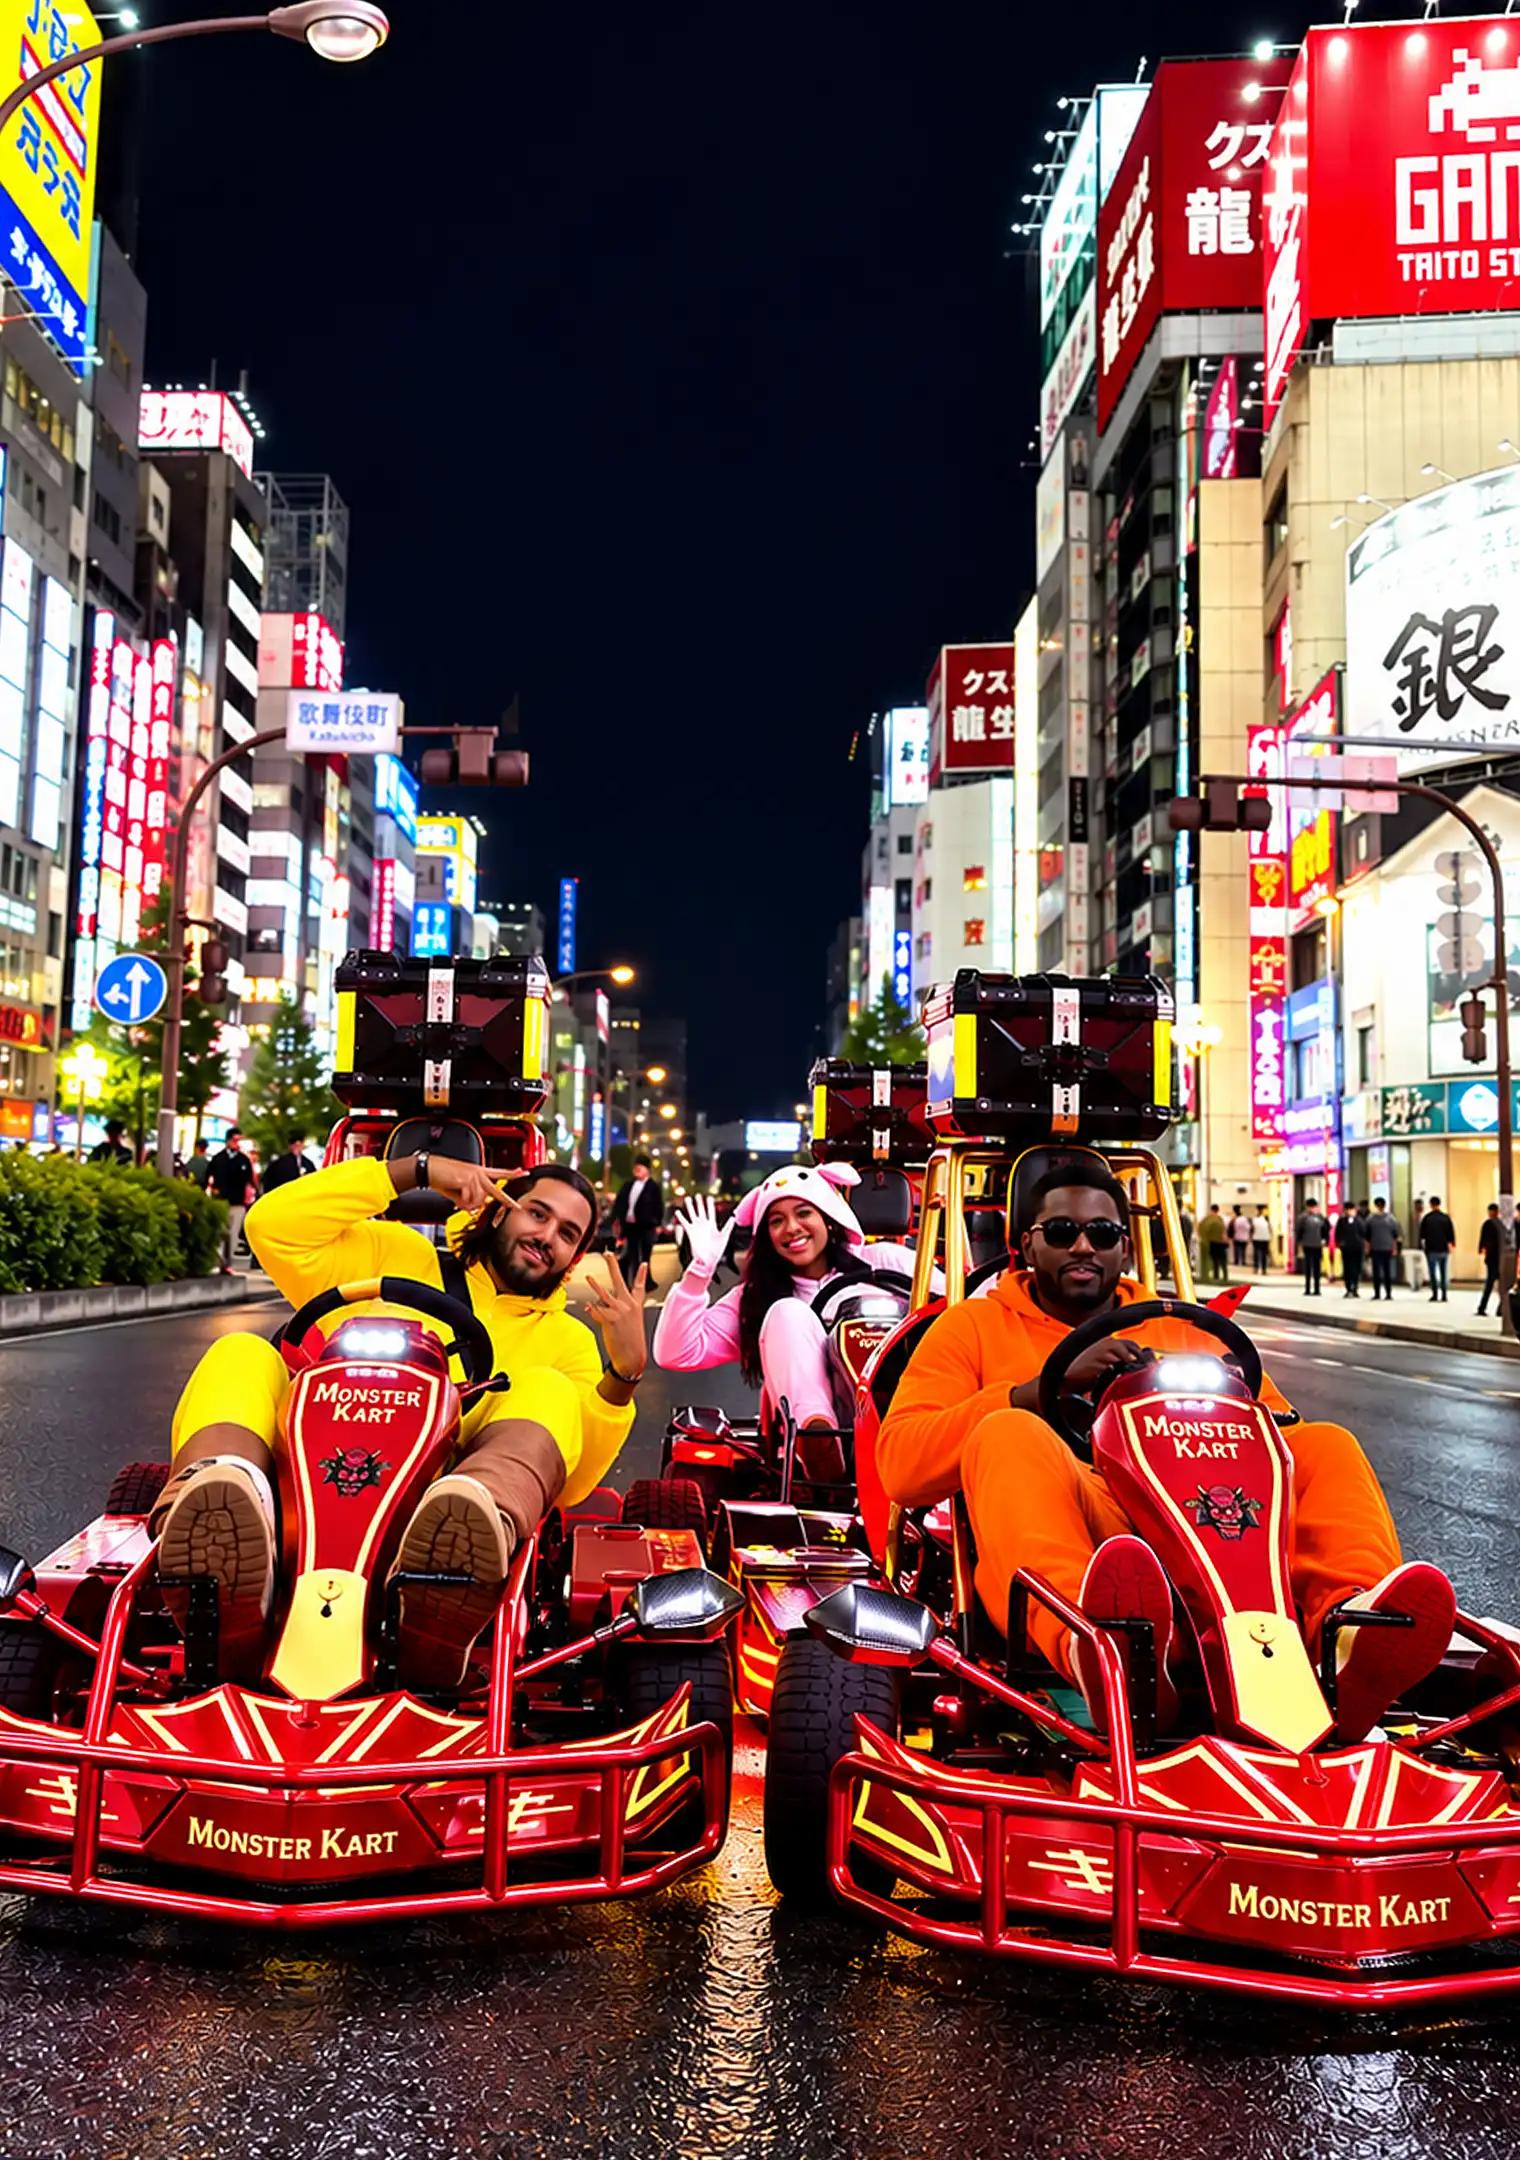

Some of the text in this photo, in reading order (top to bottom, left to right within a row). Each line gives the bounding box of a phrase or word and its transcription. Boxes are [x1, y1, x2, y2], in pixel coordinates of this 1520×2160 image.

[1397, 250, 1479, 281] TAITO
[1382, 603, 1511, 732] 銀
[962, 669, 1014, 695] クス
[313, 1382, 422, 1407] MONSTER
[332, 1402, 396, 1424] KART
[1143, 1415, 1255, 1441] MONSTER
[1172, 1437, 1239, 1460] KART
[187, 1816, 399, 1860] MONSTER KART
[1228, 1882, 1451, 1928] MONSTER KART
